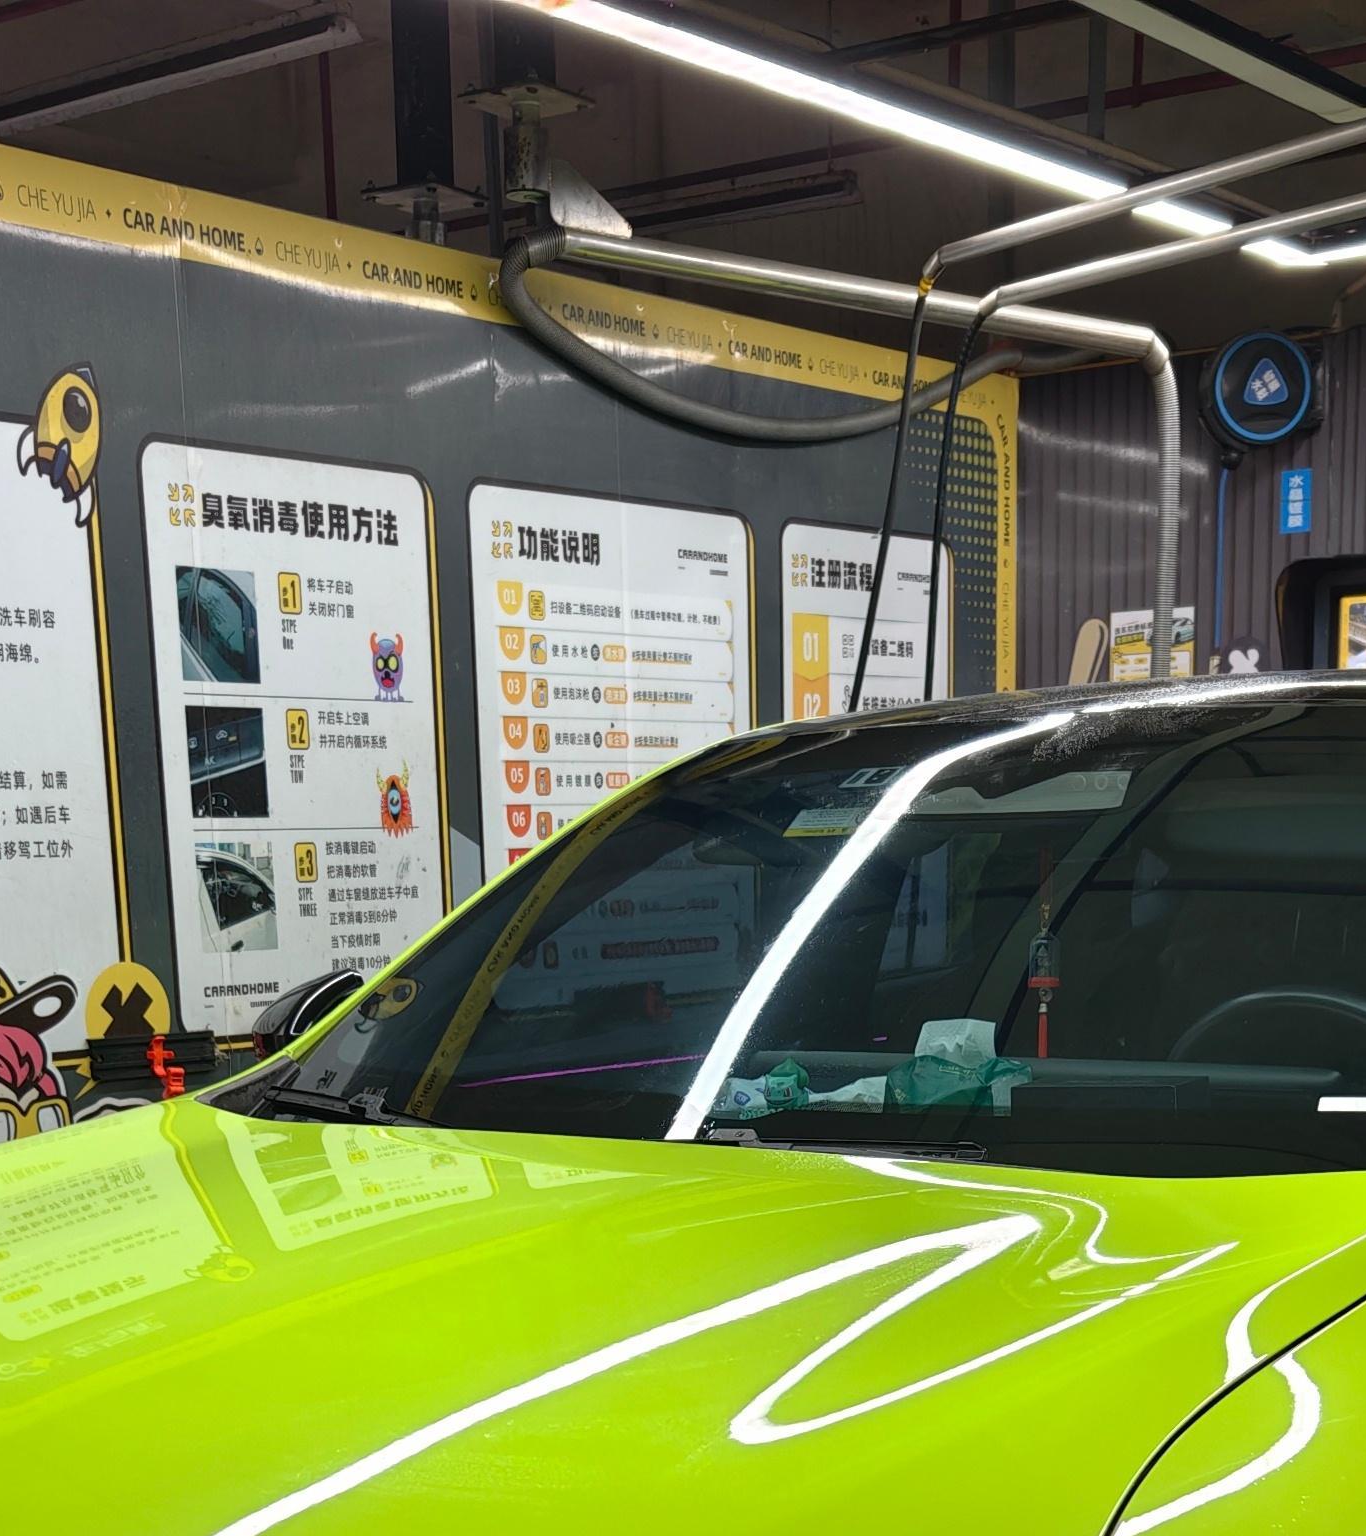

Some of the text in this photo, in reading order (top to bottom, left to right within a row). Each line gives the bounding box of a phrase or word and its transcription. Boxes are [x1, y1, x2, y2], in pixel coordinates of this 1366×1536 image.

[17, 185, 97, 222] CHE YU JIA
[123, 208, 246, 251] CAR AND HOME
[276, 242, 341, 274] CHE YU JIA
[363, 260, 463, 298] CAR AND HOME
[562, 304, 646, 336] CAR AND HOME
[728, 339, 802, 369] CAR AND HOME
[873, 370, 890, 388] CAR
[201, 492, 398, 546] 臭氧消毒使用方法
[517, 526, 601, 566] 功能说明
[811, 558, 875, 592] 注册流程
[307, 578, 353, 595] 将车子启动
[503, 588, 516, 605] 01
[309, 601, 354, 618] 关闭好门窗
[505, 633, 518, 649] 02
[803, 632, 819, 662] 01
[507, 680, 519, 694] 03
[318, 711, 369, 726] 开启车上空调
[298, 716, 305, 744] 2
[509, 726, 522, 739] 04
[319, 735, 387, 749] 并开启内循环系统
[290, 755, 305, 768] STPE
[511, 769, 523, 782] 05
[513, 812, 525, 826] 06
[326, 841, 376, 855] 按消毒键启动
[306, 849, 313, 876] 3
[327, 864, 377, 878] 把消毒的软管
[298, 888, 313, 900] STPE
[299, 904, 317, 916] THREE
[331, 933, 380, 948] 当下疫情时期
[204, 982, 279, 997] CARANDHOME
